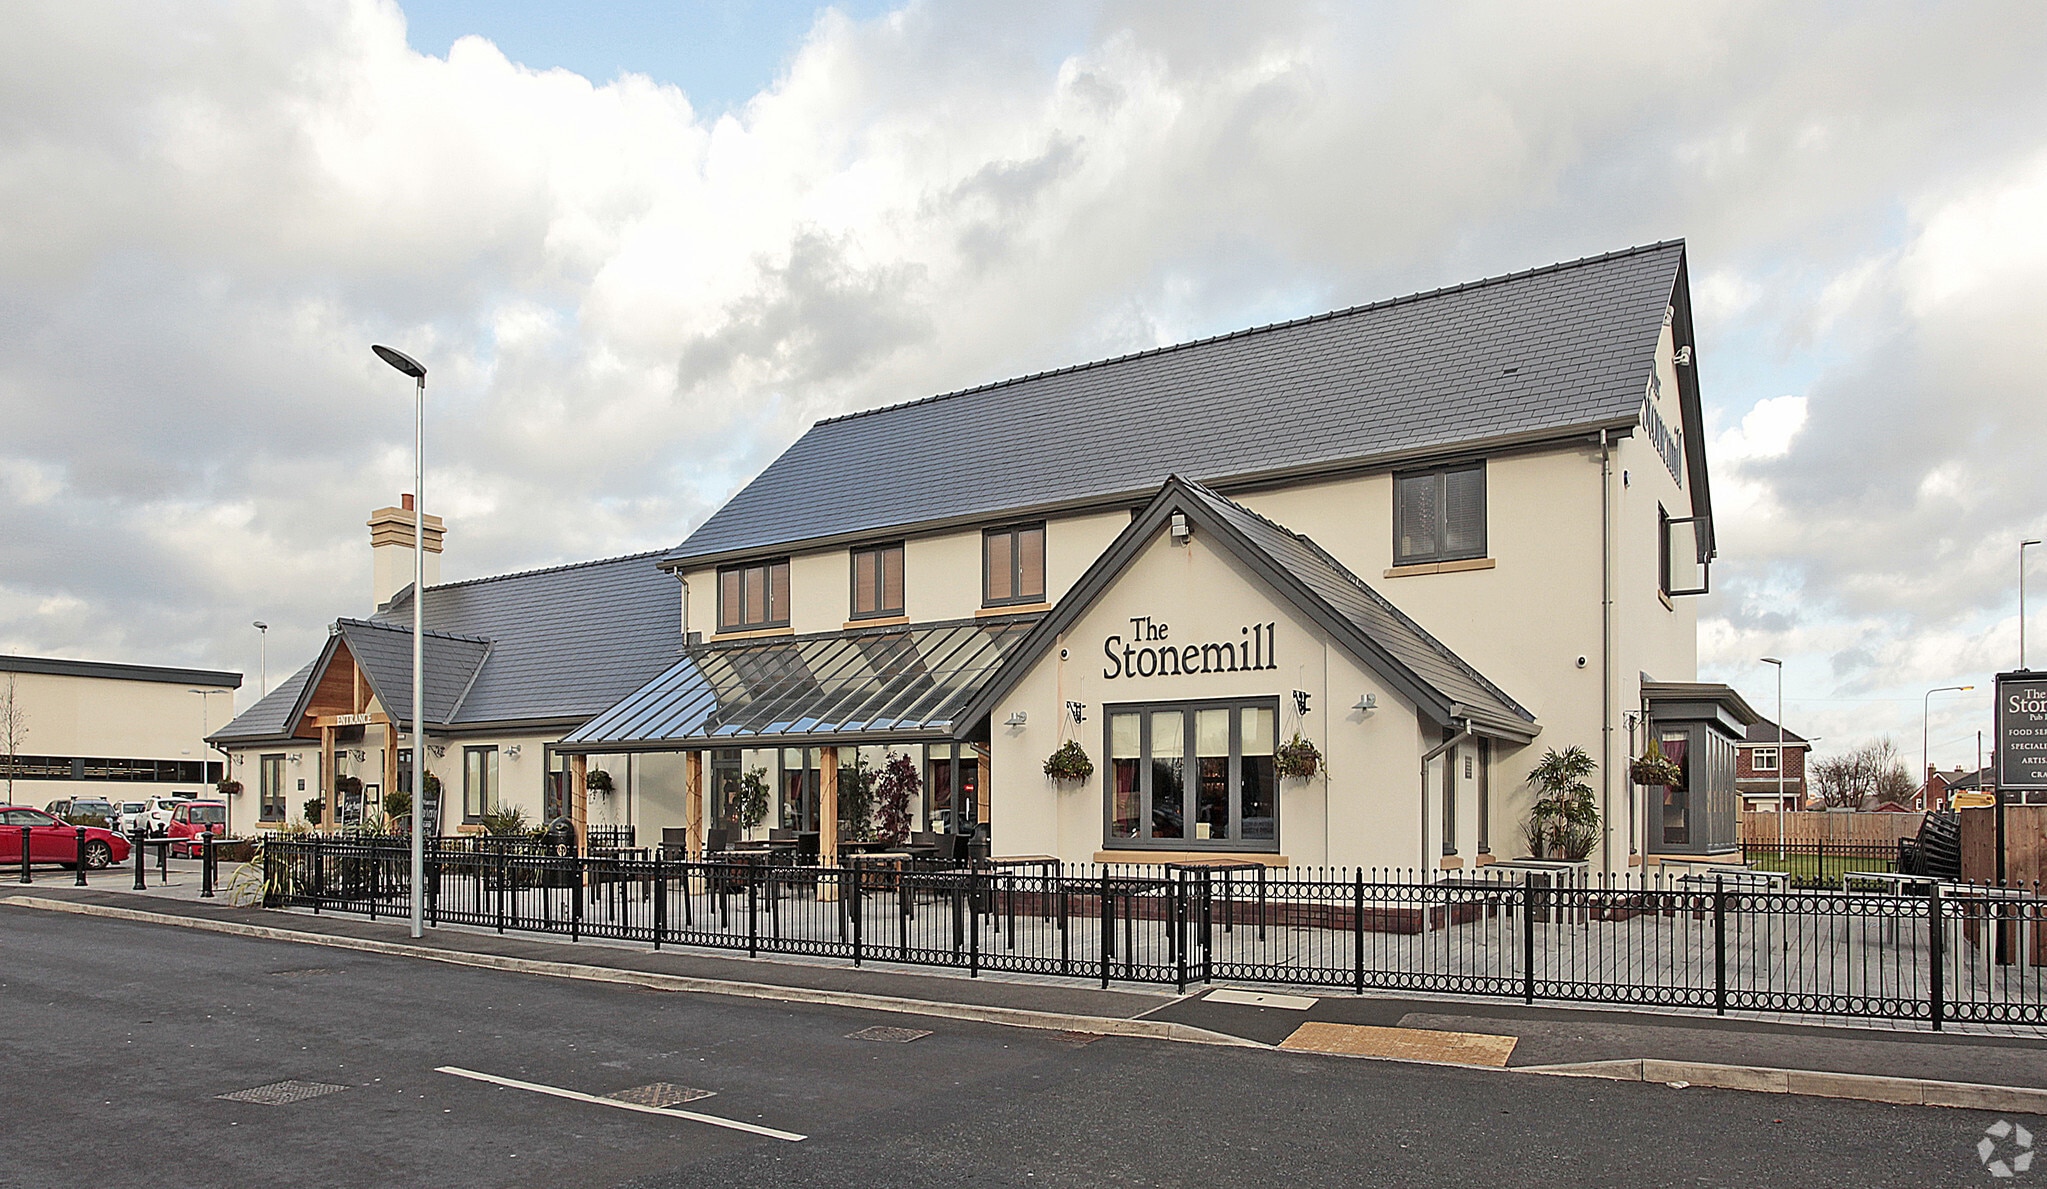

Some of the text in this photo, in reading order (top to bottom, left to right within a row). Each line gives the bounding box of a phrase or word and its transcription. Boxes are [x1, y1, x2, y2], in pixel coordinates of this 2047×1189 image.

[1130, 616, 1168, 641] The
[1103, 622, 1277, 679] Stonemill
[2024, 689, 2046, 699] The
[336, 713, 372, 726] ENTRANCE
